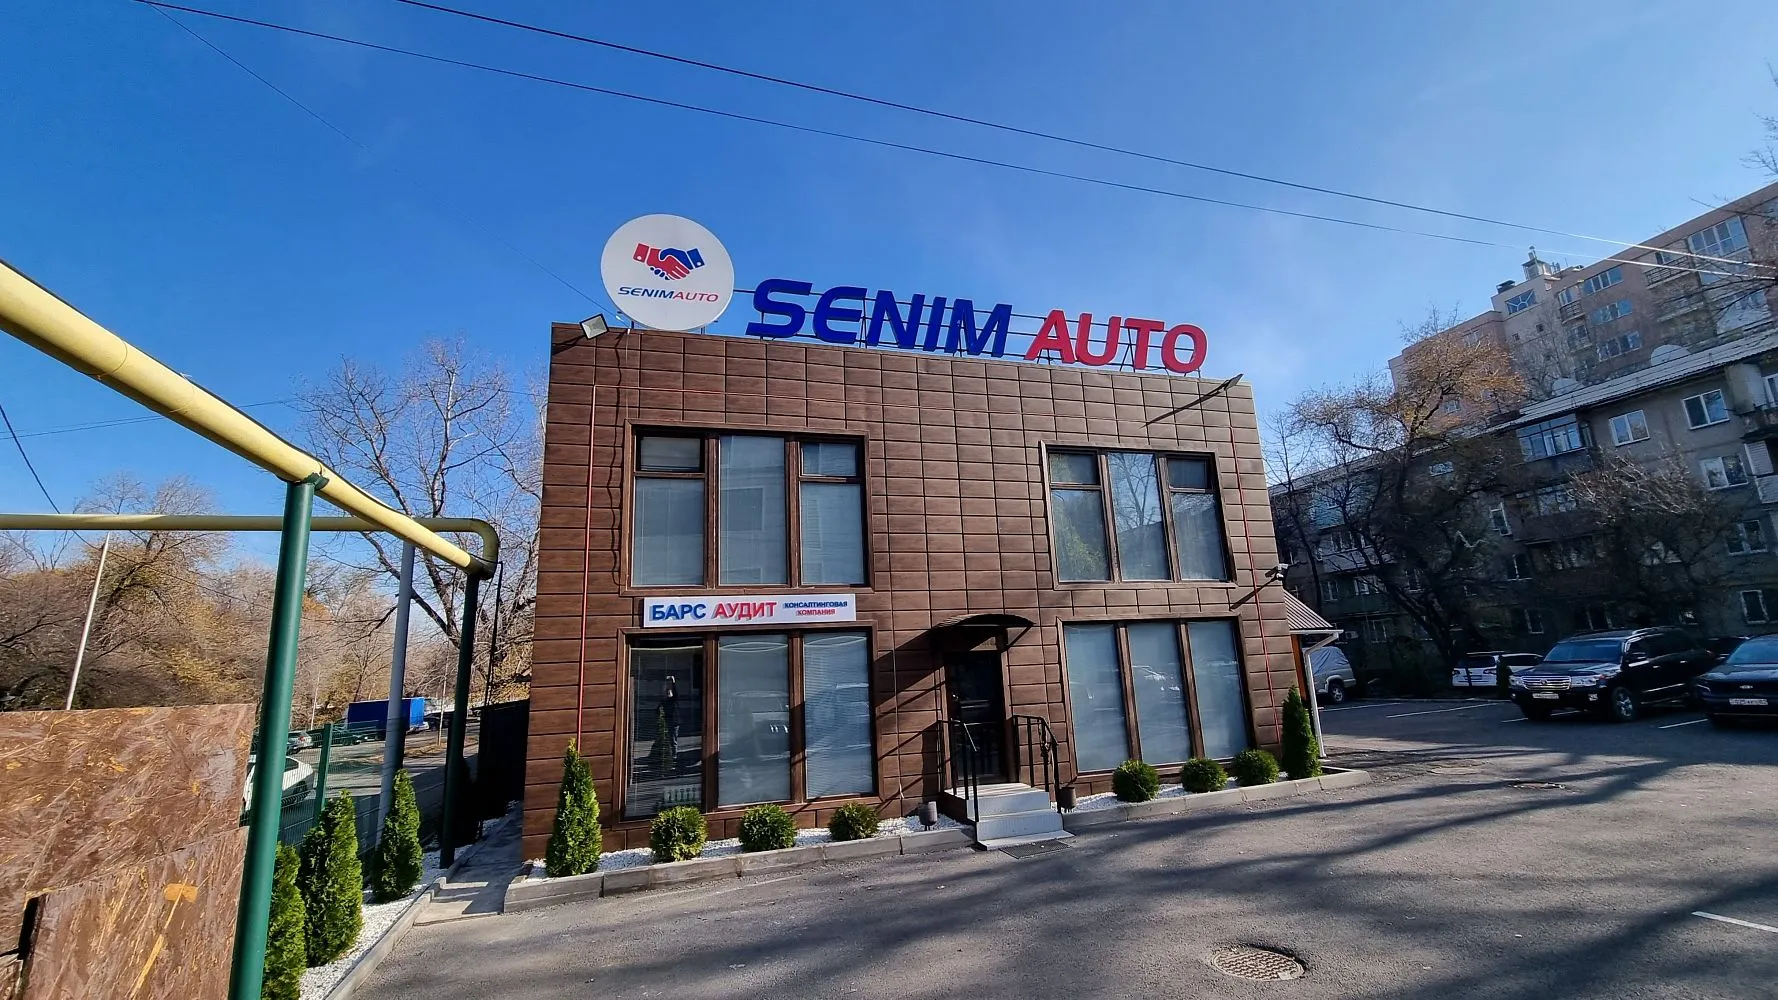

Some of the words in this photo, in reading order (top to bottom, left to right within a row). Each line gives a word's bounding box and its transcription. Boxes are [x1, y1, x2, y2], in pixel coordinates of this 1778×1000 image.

[618, 286, 719, 302] SENIMAUTO
[745, 278, 1013, 358] SENIM
[1024, 309, 1208, 373] AUTO
[651, 603, 706, 620] БАРС
[713, 602, 777, 620] АУДИТ
[784, 600, 848, 608] КОНСАЛТИНГОВАЯ
[797, 608, 836, 616] КОМПАНИЯ
